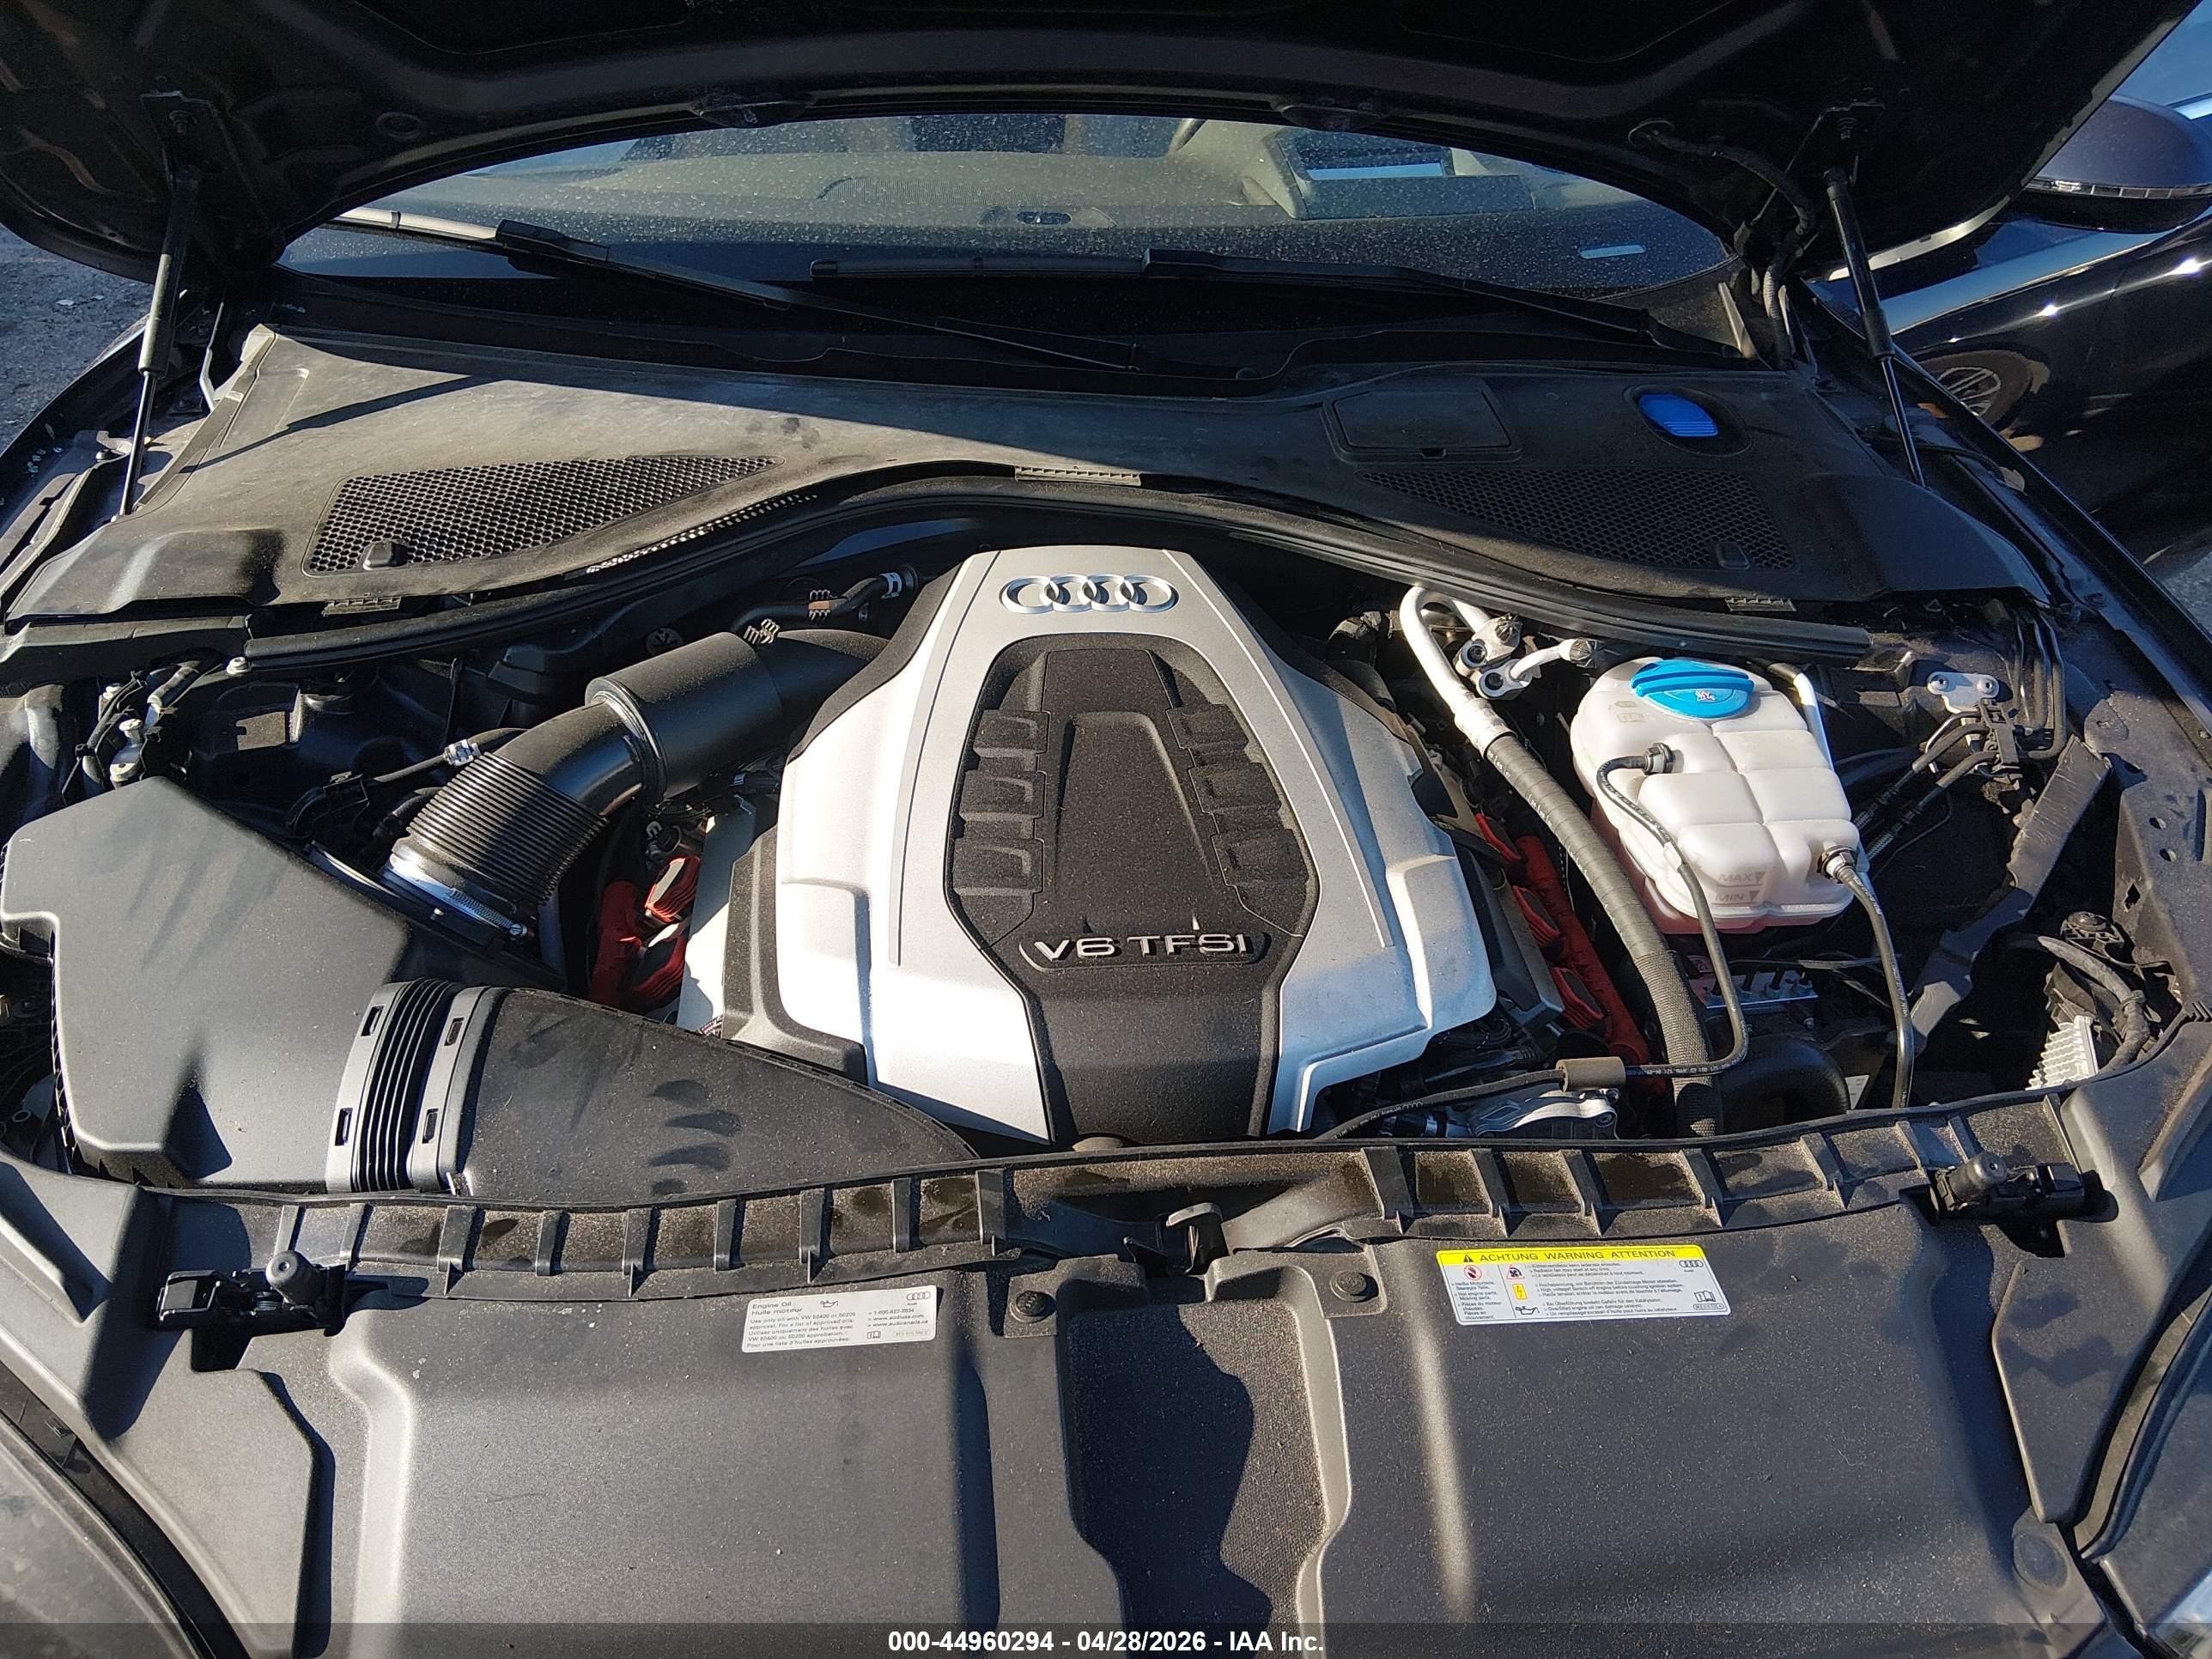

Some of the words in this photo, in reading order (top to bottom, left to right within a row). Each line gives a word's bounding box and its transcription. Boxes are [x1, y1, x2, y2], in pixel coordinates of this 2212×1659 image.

[1718, 872, 1752, 881] MAX
[1715, 892, 1745, 901] MIN
[1034, 937, 1115, 962] V6
[1127, 933, 1248, 957] TFSI
[1480, 1253, 1539, 1261] ACHTUNG
